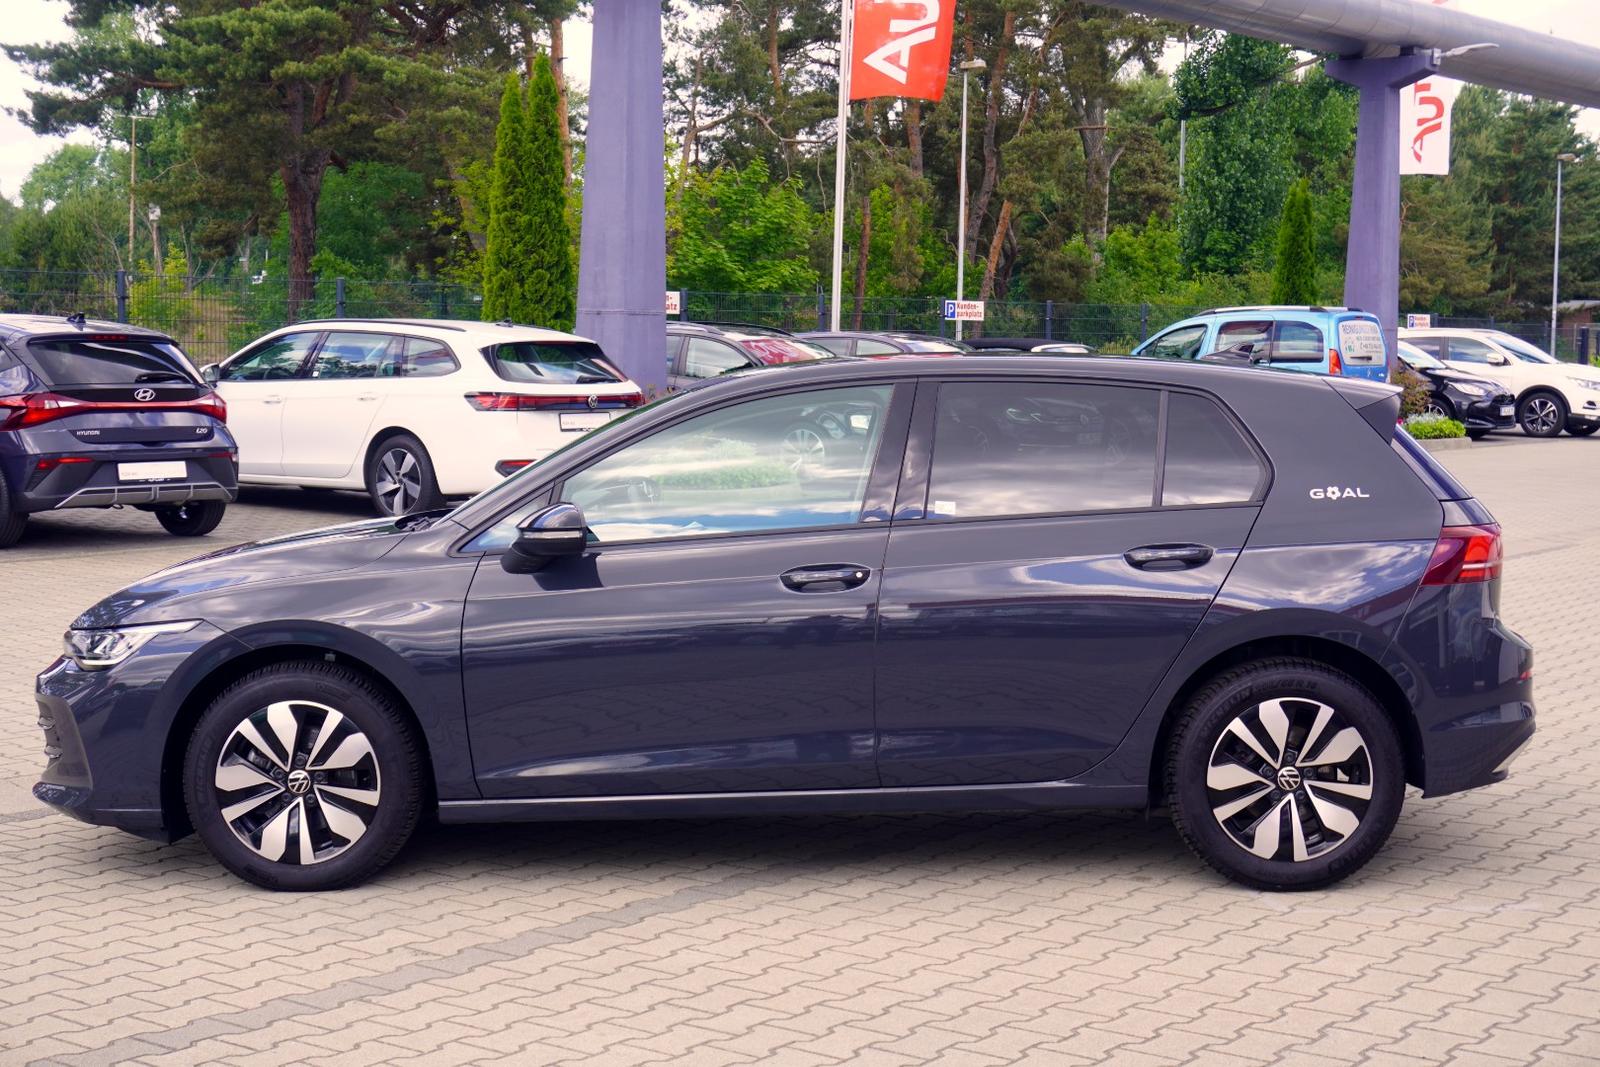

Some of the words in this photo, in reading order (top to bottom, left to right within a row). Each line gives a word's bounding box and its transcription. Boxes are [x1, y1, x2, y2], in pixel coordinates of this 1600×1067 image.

[957, 311, 982, 319] parkplatz
[196, 427, 208, 435] i20
[1309, 486, 1370, 500] GOAL
